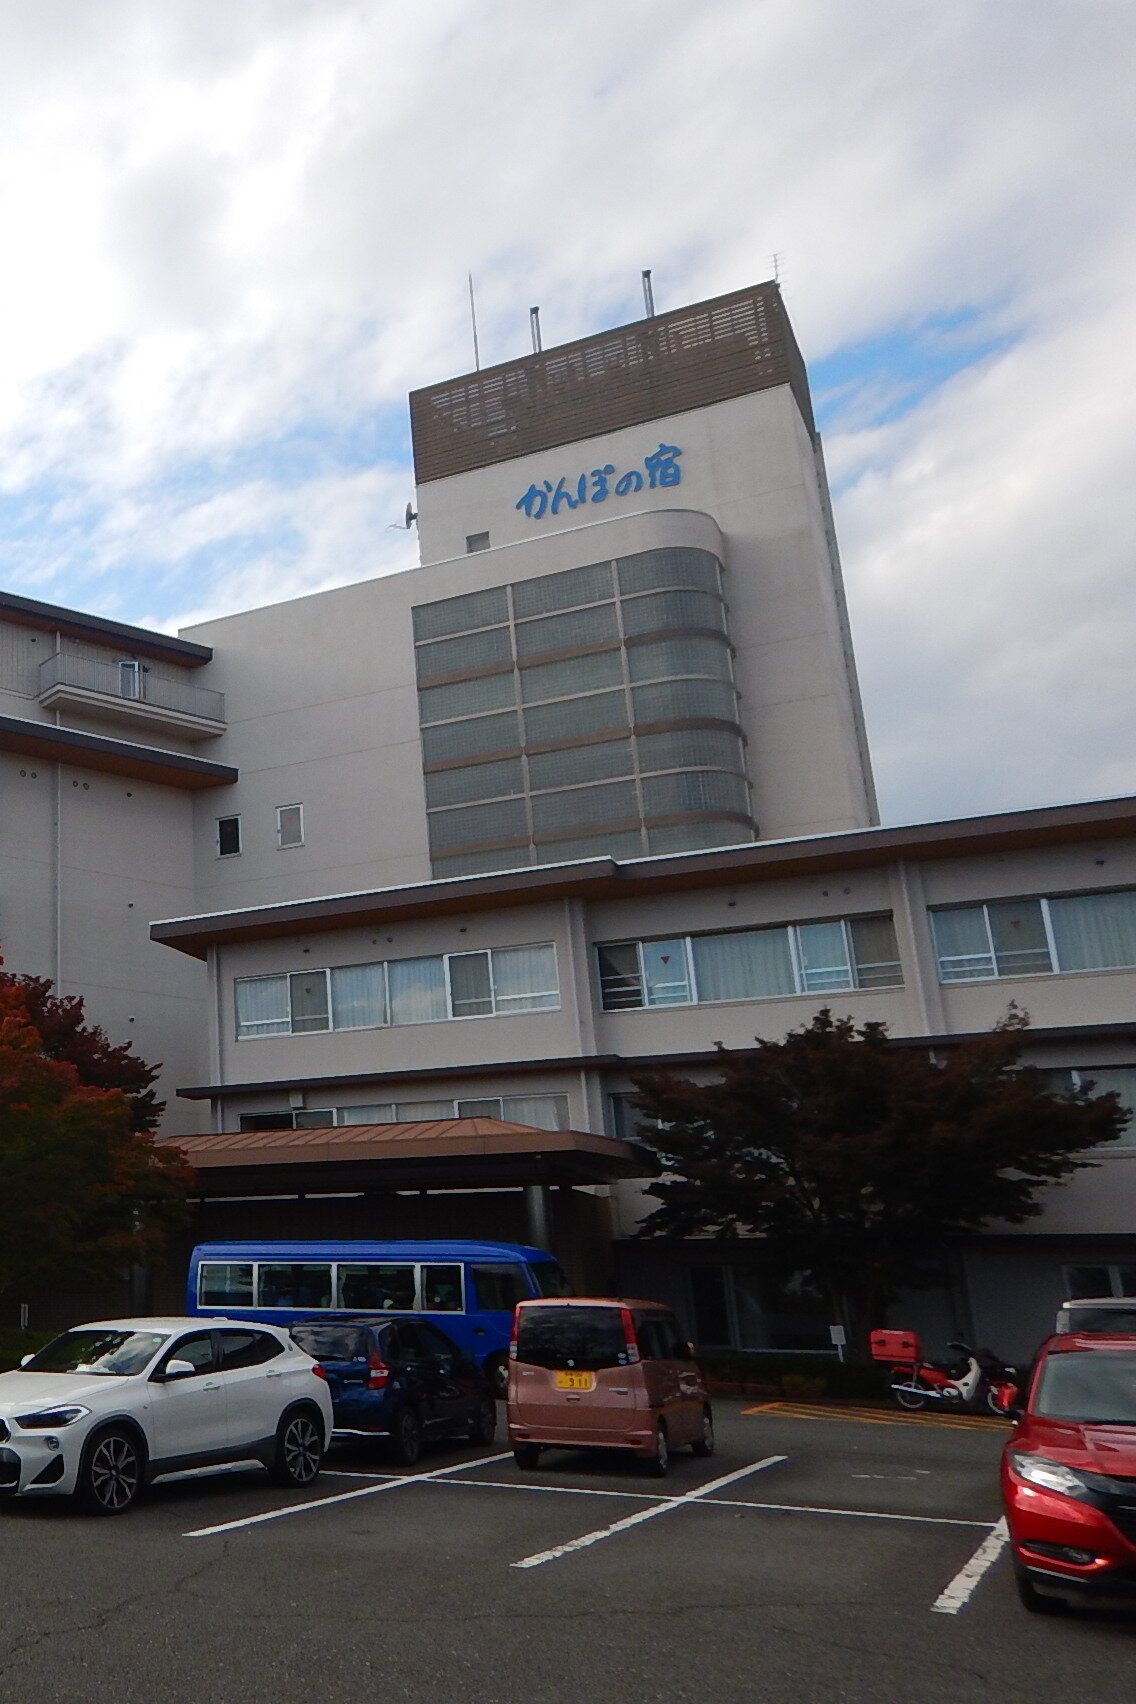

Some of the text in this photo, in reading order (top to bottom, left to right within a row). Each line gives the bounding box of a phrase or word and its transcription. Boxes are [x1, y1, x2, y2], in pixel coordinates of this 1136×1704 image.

[515, 442, 683, 520] かんぽの宿
